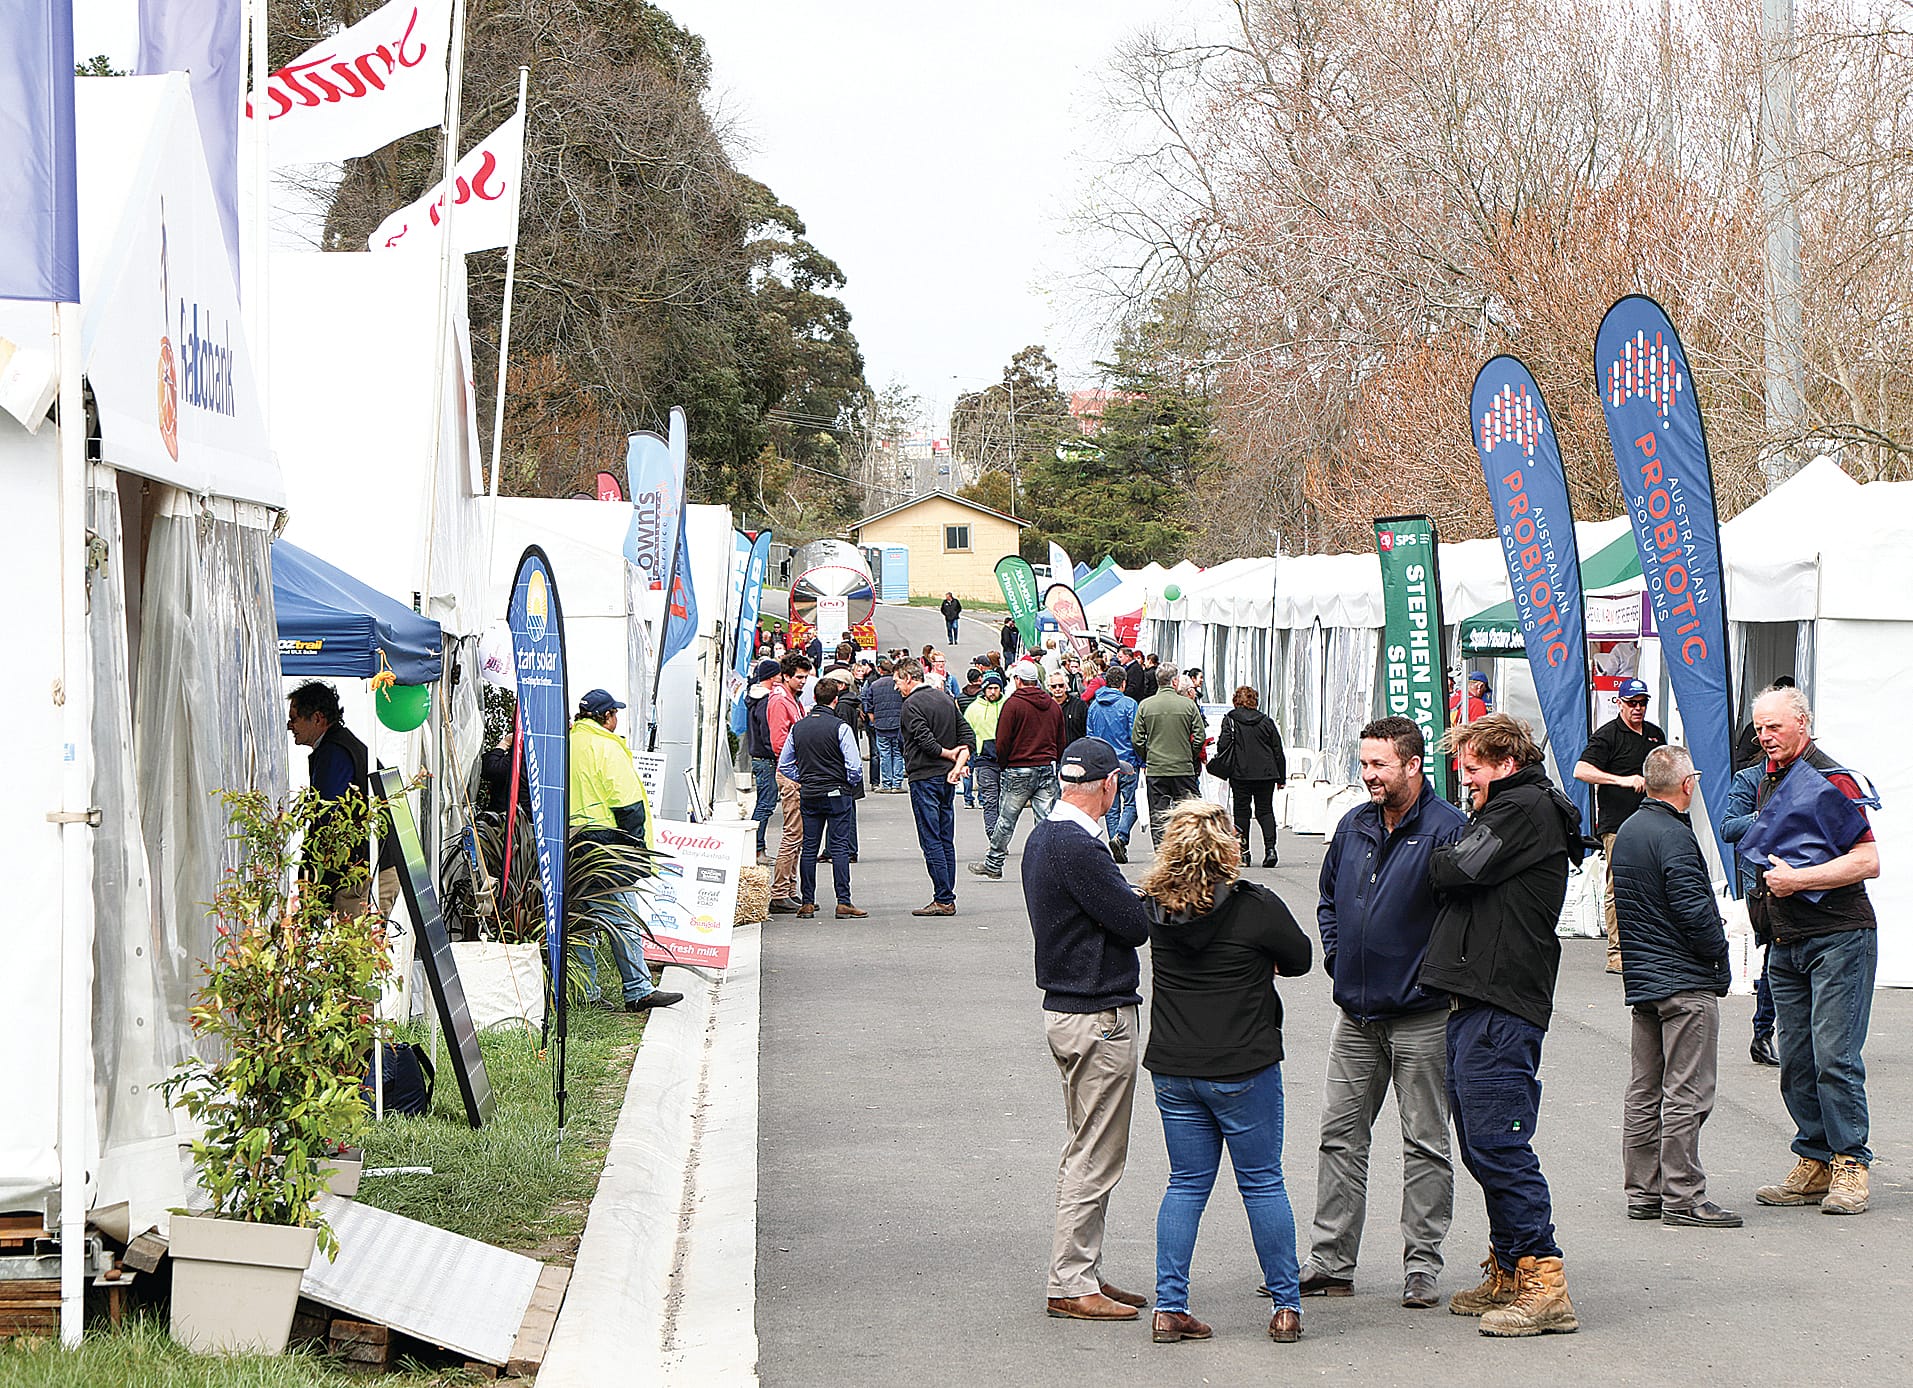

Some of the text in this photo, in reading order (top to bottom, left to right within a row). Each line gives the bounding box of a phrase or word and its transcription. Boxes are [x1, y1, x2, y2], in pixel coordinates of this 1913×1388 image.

[180, 297, 236, 418] Rabobank
[636, 491, 656, 581] own's
[1395, 533, 1417, 547] SPS
[1502, 524, 1536, 632] SOLUTIONS
[1532, 507, 1570, 615] AUSTRALIAN
[1633, 495, 1670, 622] SOLUTIONS
[1667, 477, 1709, 604] AUSTRALIAN
[517, 646, 536, 671] tart
[536, 645, 558, 672] solar
[1405, 564, 1431, 683] STEPHEN
[1387, 644, 1410, 719] SEED
[534, 813, 547, 851] for
[655, 829, 723, 850] Saputo
[539, 850, 557, 935] Future
[697, 899, 714, 907] ROAD
[668, 942, 695, 955] fresh
[696, 947, 719, 958] milk
